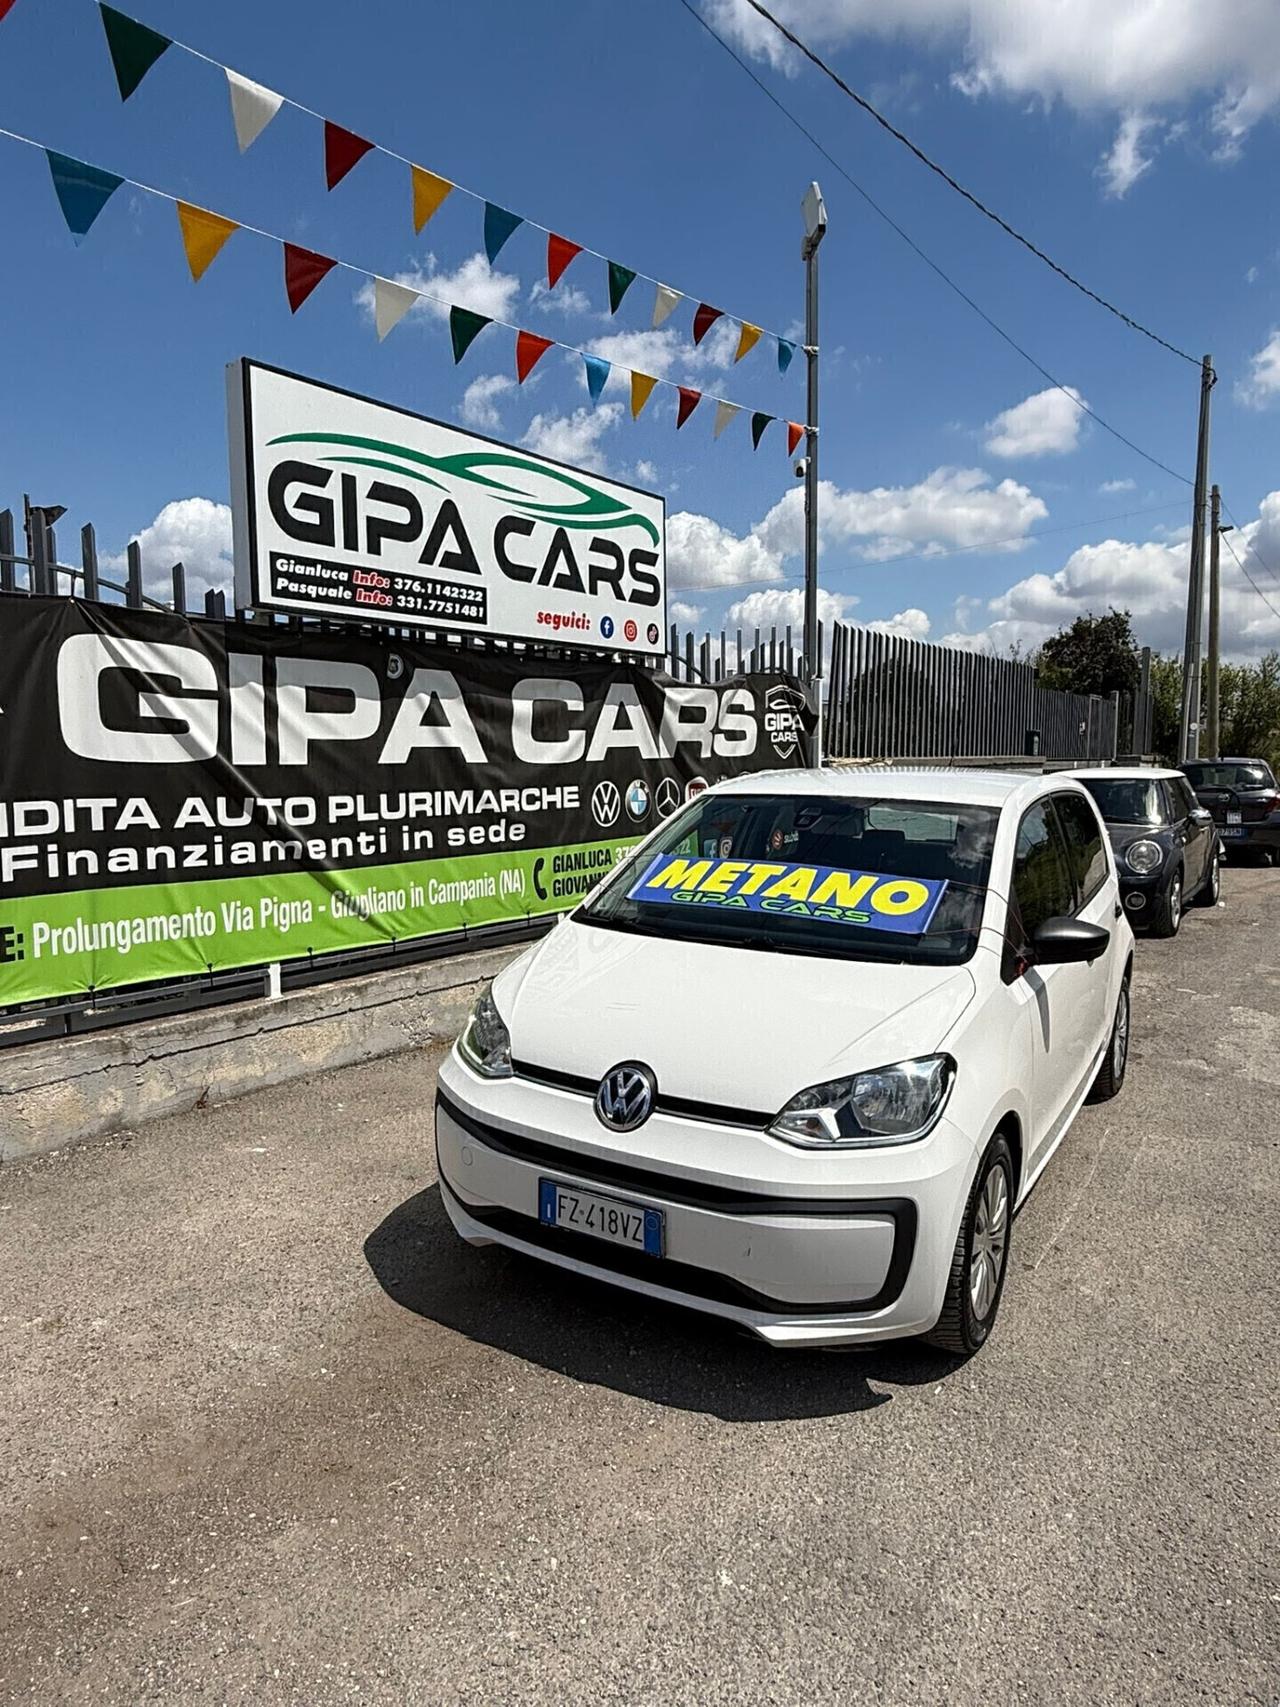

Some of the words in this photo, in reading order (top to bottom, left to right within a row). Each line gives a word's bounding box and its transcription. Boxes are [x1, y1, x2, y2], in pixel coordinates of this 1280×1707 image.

[268, 460, 482, 575] GIPA
[493, 515, 661, 607] CARS
[275, 558, 349, 581] Gianluca
[353, 570, 391, 588] Info:
[394, 577, 484, 602] 376.1142322
[276, 578, 352, 600] Pasquale
[355, 588, 394, 607] Info:
[397, 595, 485, 618] 331.7751481
[536, 610, 591, 631] seguici:
[57, 633, 488, 765] GIPA
[511, 677, 758, 764] CARS
[765, 713, 805, 731] GIPA
[770, 731, 798, 743] CARS
[173, 796, 316, 829] AUTO
[328, 786, 581, 823] PLURIMARCHE
[1, 827, 387, 882] Finanziamenti
[402, 825, 434, 851] in
[447, 818, 526, 847] sede
[553, 849, 612, 874] GIANLUCA
[646, 859, 930, 916] METANO
[671, 889, 749, 909] GIPA
[760, 899, 873, 924] CARS
[32, 905, 217, 959] Prolungamento
[220, 901, 255, 933] Via
[259, 896, 313, 933] Pigna
[331, 885, 406, 922] Giugliano
[410, 881, 425, 908] in
[428, 873, 497, 906] Campania
[499, 868, 526, 899] (NA)
